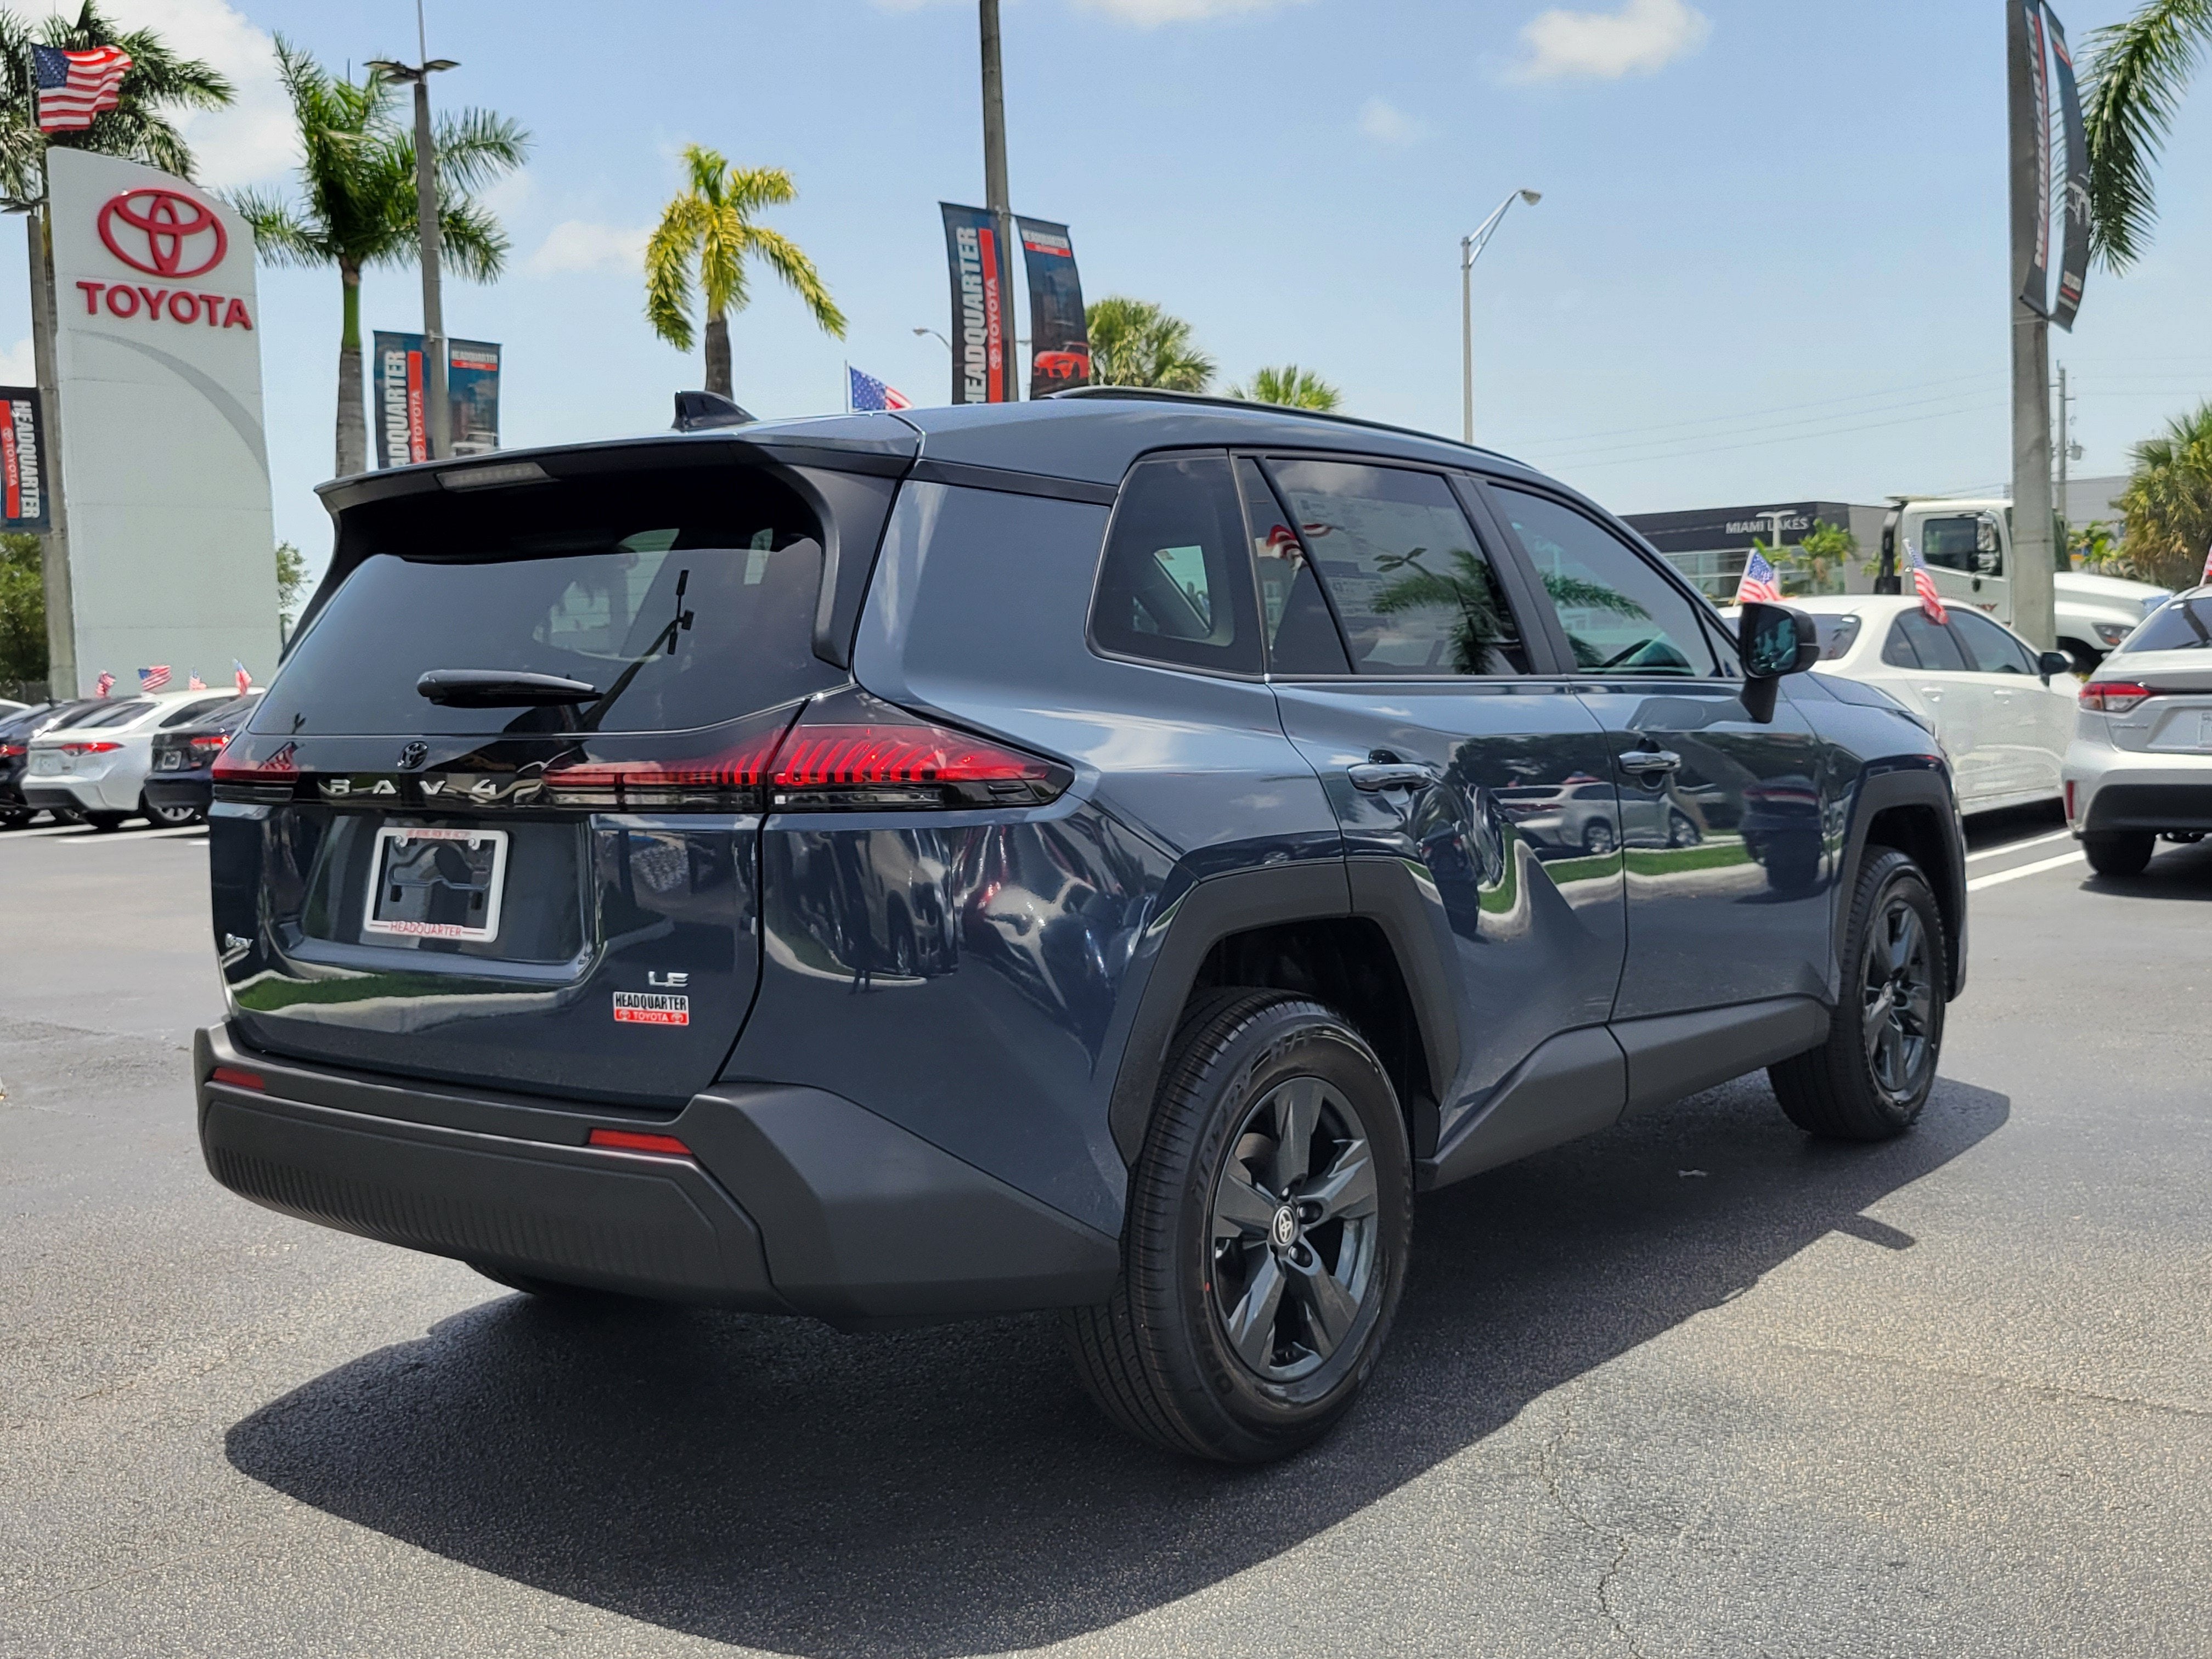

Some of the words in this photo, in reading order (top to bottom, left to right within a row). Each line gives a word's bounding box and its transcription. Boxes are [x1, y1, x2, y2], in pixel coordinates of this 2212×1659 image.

[76, 281, 253, 330] TOYOTA
[986, 278, 1000, 345] TOYOTA
[385, 350, 411, 467] ADQUARTER
[412, 390, 424, 443] TOYOTA
[6, 443, 18, 487] TOYOTA
[12, 400, 41, 518] HEADQUARTER
[1725, 520, 1764, 534] MIAMI
[330, 778, 496, 795] RAV4
[391, 922, 461, 936] HEADQUARTER
[648, 971, 689, 988] LE
[615, 993, 686, 1011] HEADQUARTER
[633, 1011, 669, 1022] TOYOTA
